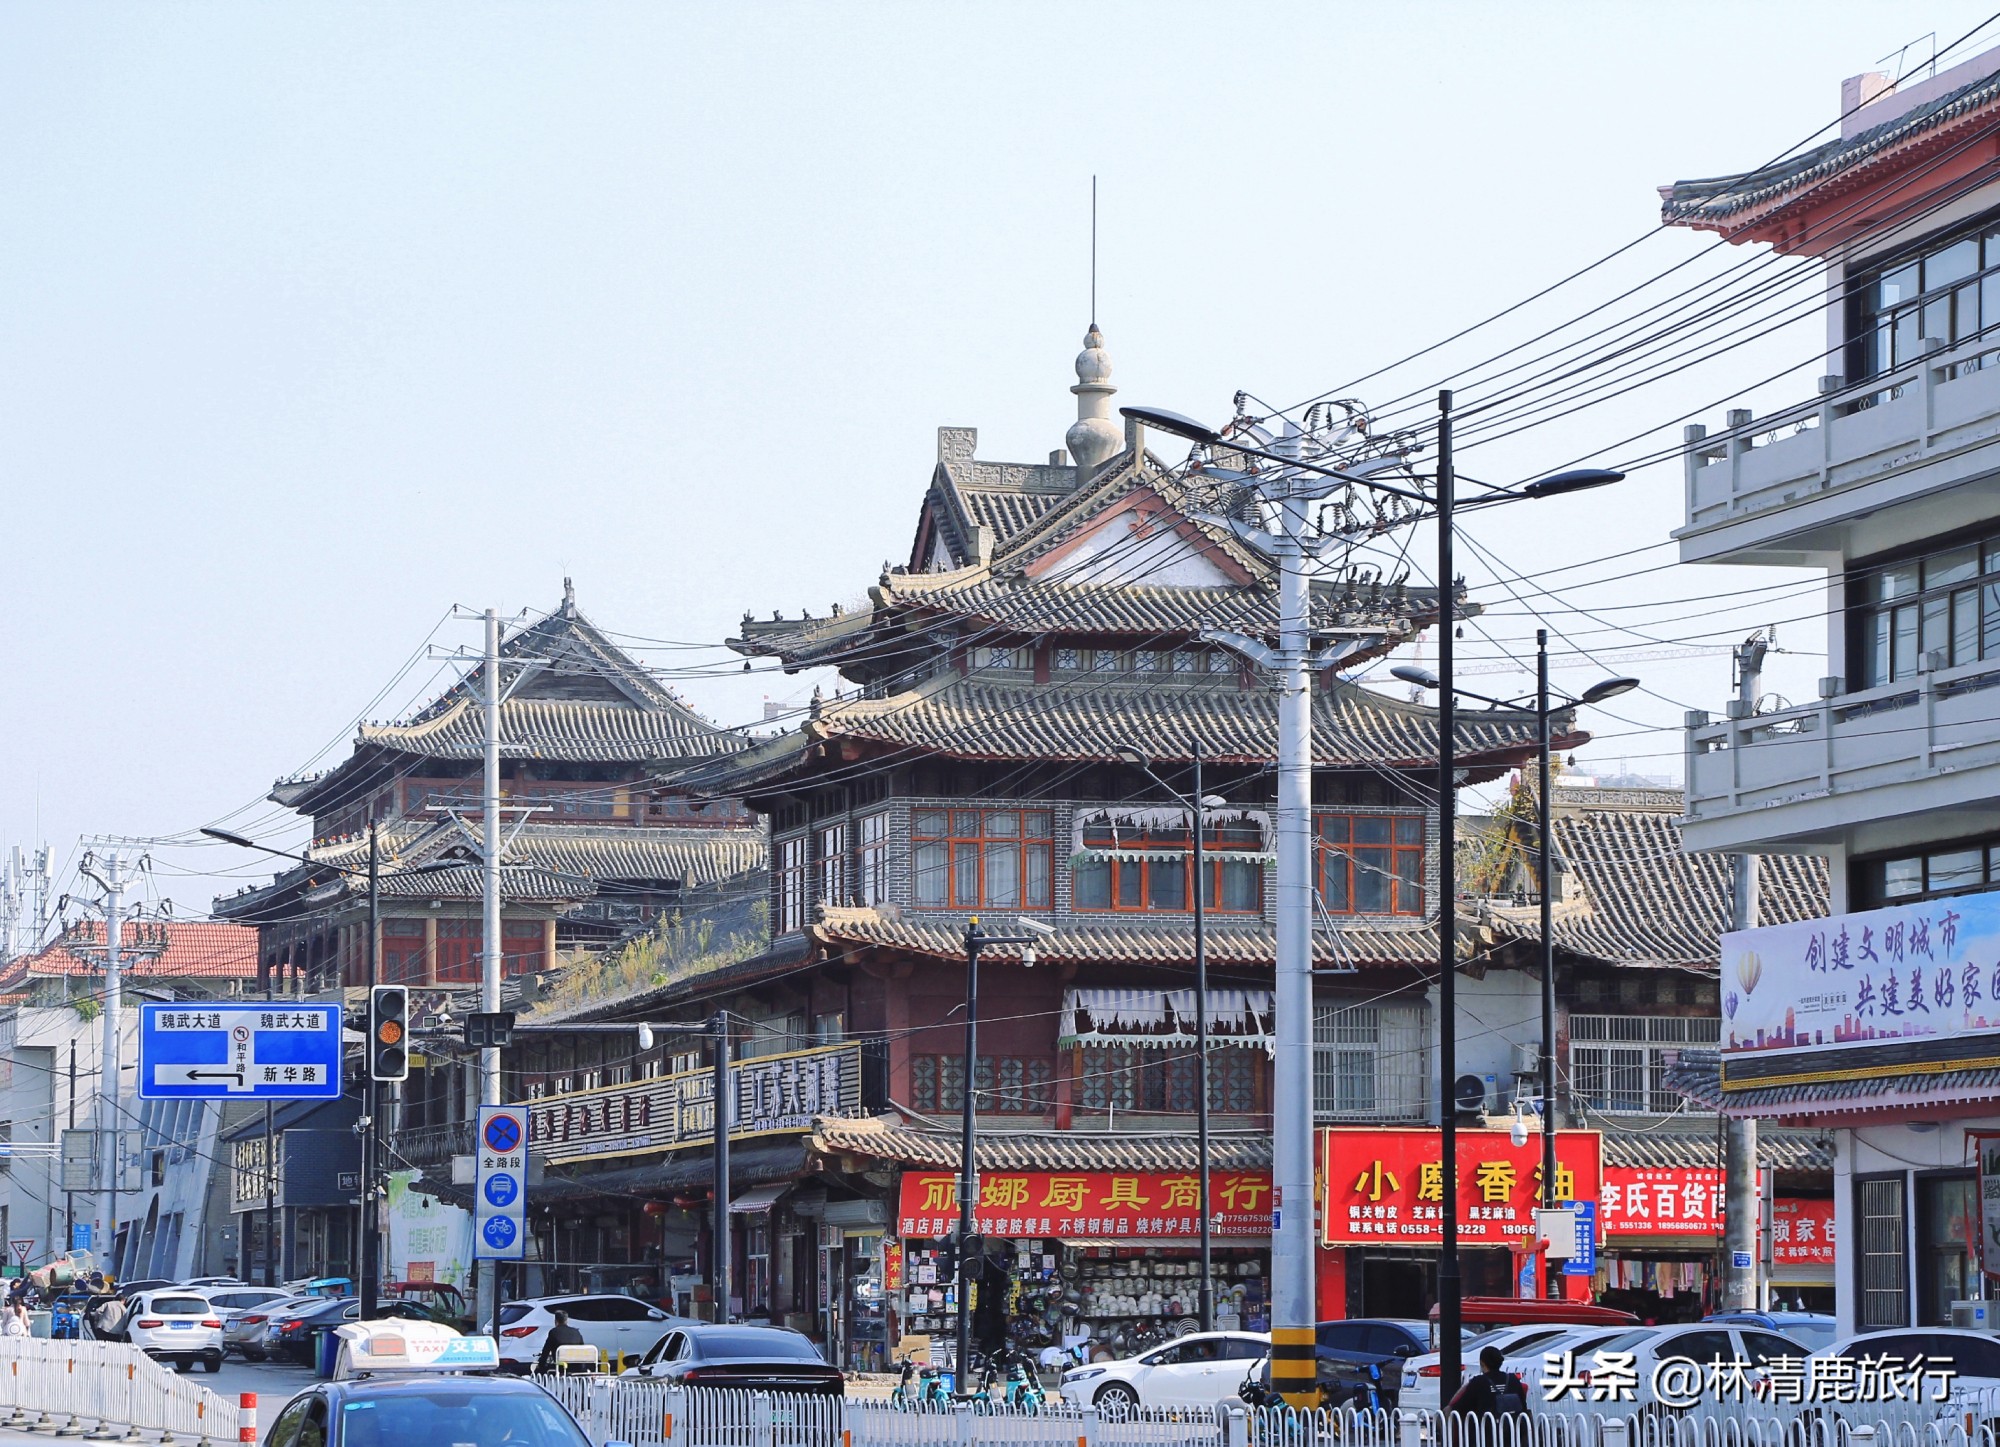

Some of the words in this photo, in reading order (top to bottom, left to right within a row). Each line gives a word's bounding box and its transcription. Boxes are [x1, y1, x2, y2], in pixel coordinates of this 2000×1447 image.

[1805, 910, 1961, 974] 创建文明城市
[161, 1013, 221, 1029] 魏武大道
[260, 1013, 320, 1029] 魏武大道
[236, 1042, 247, 1073] 和平路
[263, 1066, 316, 1082] 新华路
[483, 1156, 521, 1169] 全路段
[1354, 1160, 1575, 1203] 小磨香油
[1636, 1172, 1672, 1181] 诚信经营
[919, 1175, 1270, 1212] 丽娜厨具商行
[1601, 1181, 1761, 1219] 李氏百货商
[1348, 1205, 1398, 1219] 铜关粉皮
[1469, 1206, 1516, 1220] 黑芝麻油
[1058, 1216, 1129, 1235] 不锈钢制品
[1348, 1221, 1398, 1234] 联系电话
[1400, 1224, 1486, 1235] 0558-59228
[17, 1243, 27, 1252] 让
[414, 1345, 445, 1353] TAXI
[452, 1339, 491, 1354] 交通
